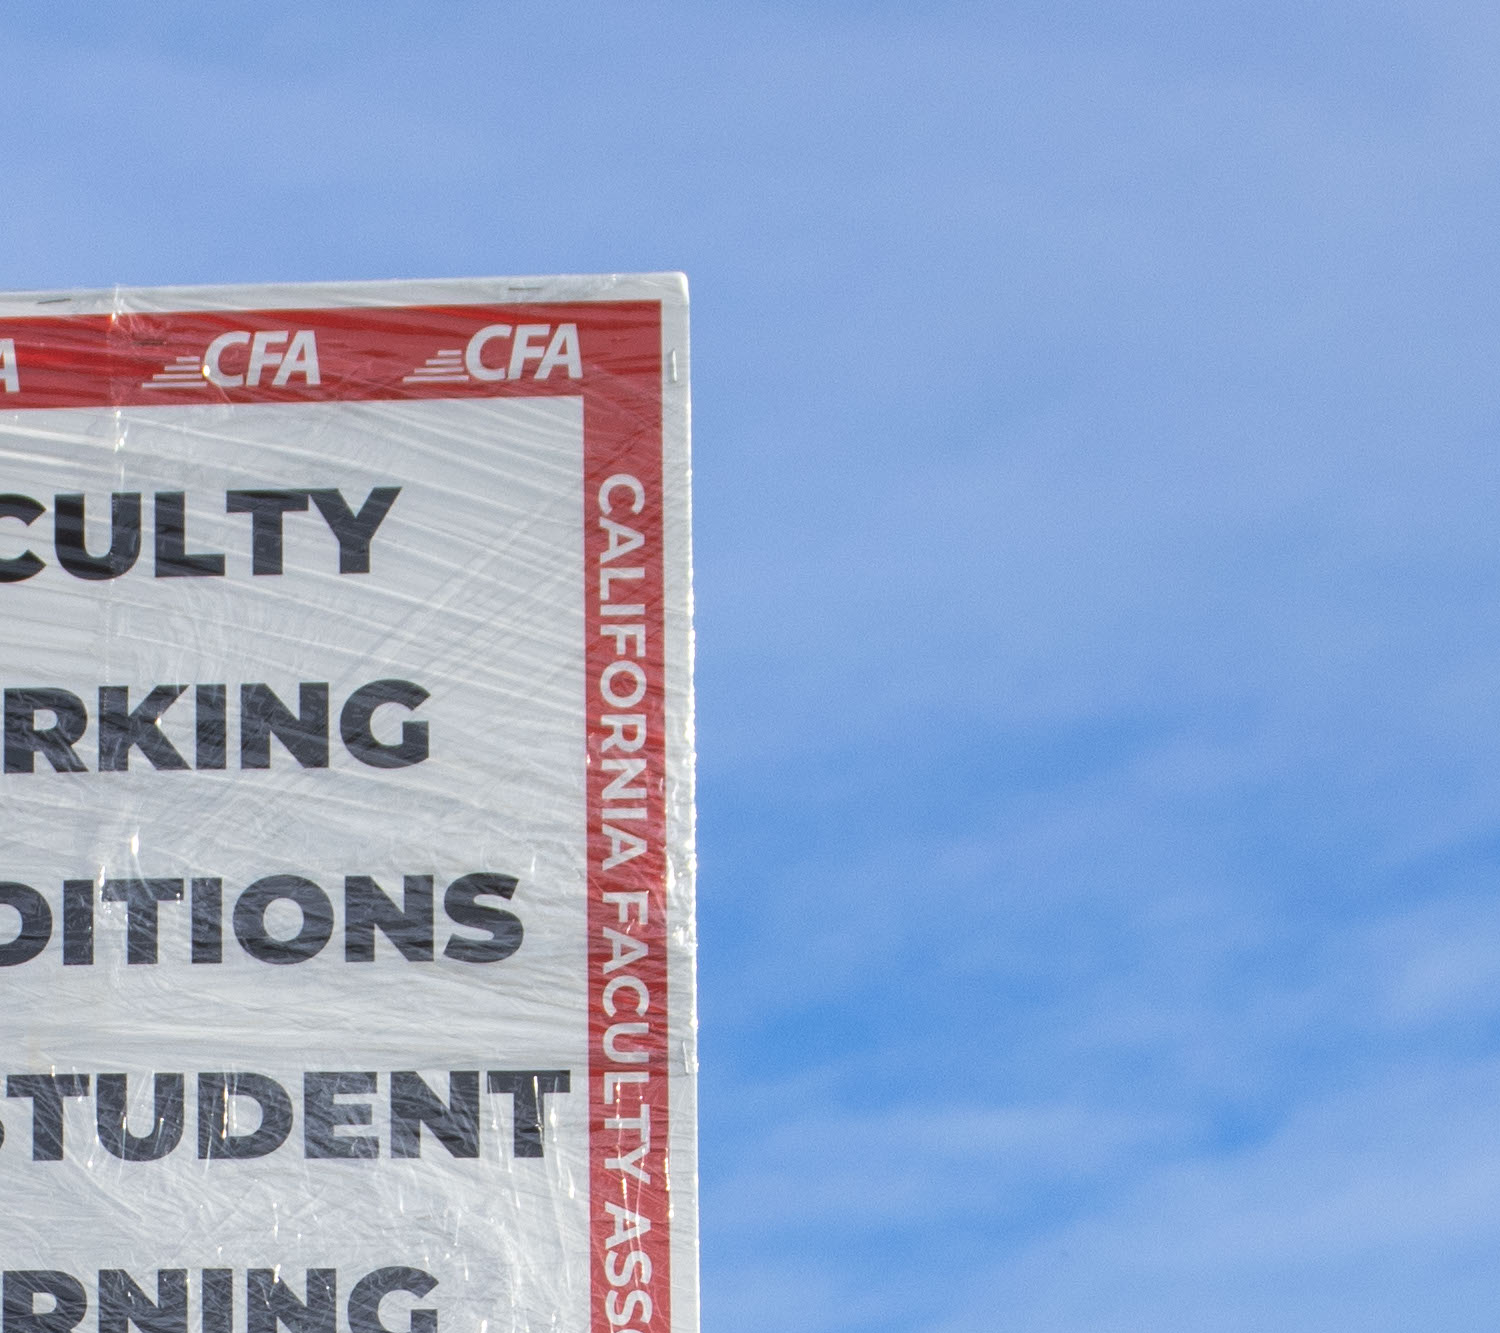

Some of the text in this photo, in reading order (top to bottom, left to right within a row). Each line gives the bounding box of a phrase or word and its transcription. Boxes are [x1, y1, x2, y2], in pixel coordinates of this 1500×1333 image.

[202, 329, 322, 389] CFA
[465, 322, 584, 381] CFA
[598, 473, 648, 871] CALIFORNIA
[601, 889, 652, 1184] FACULTY
